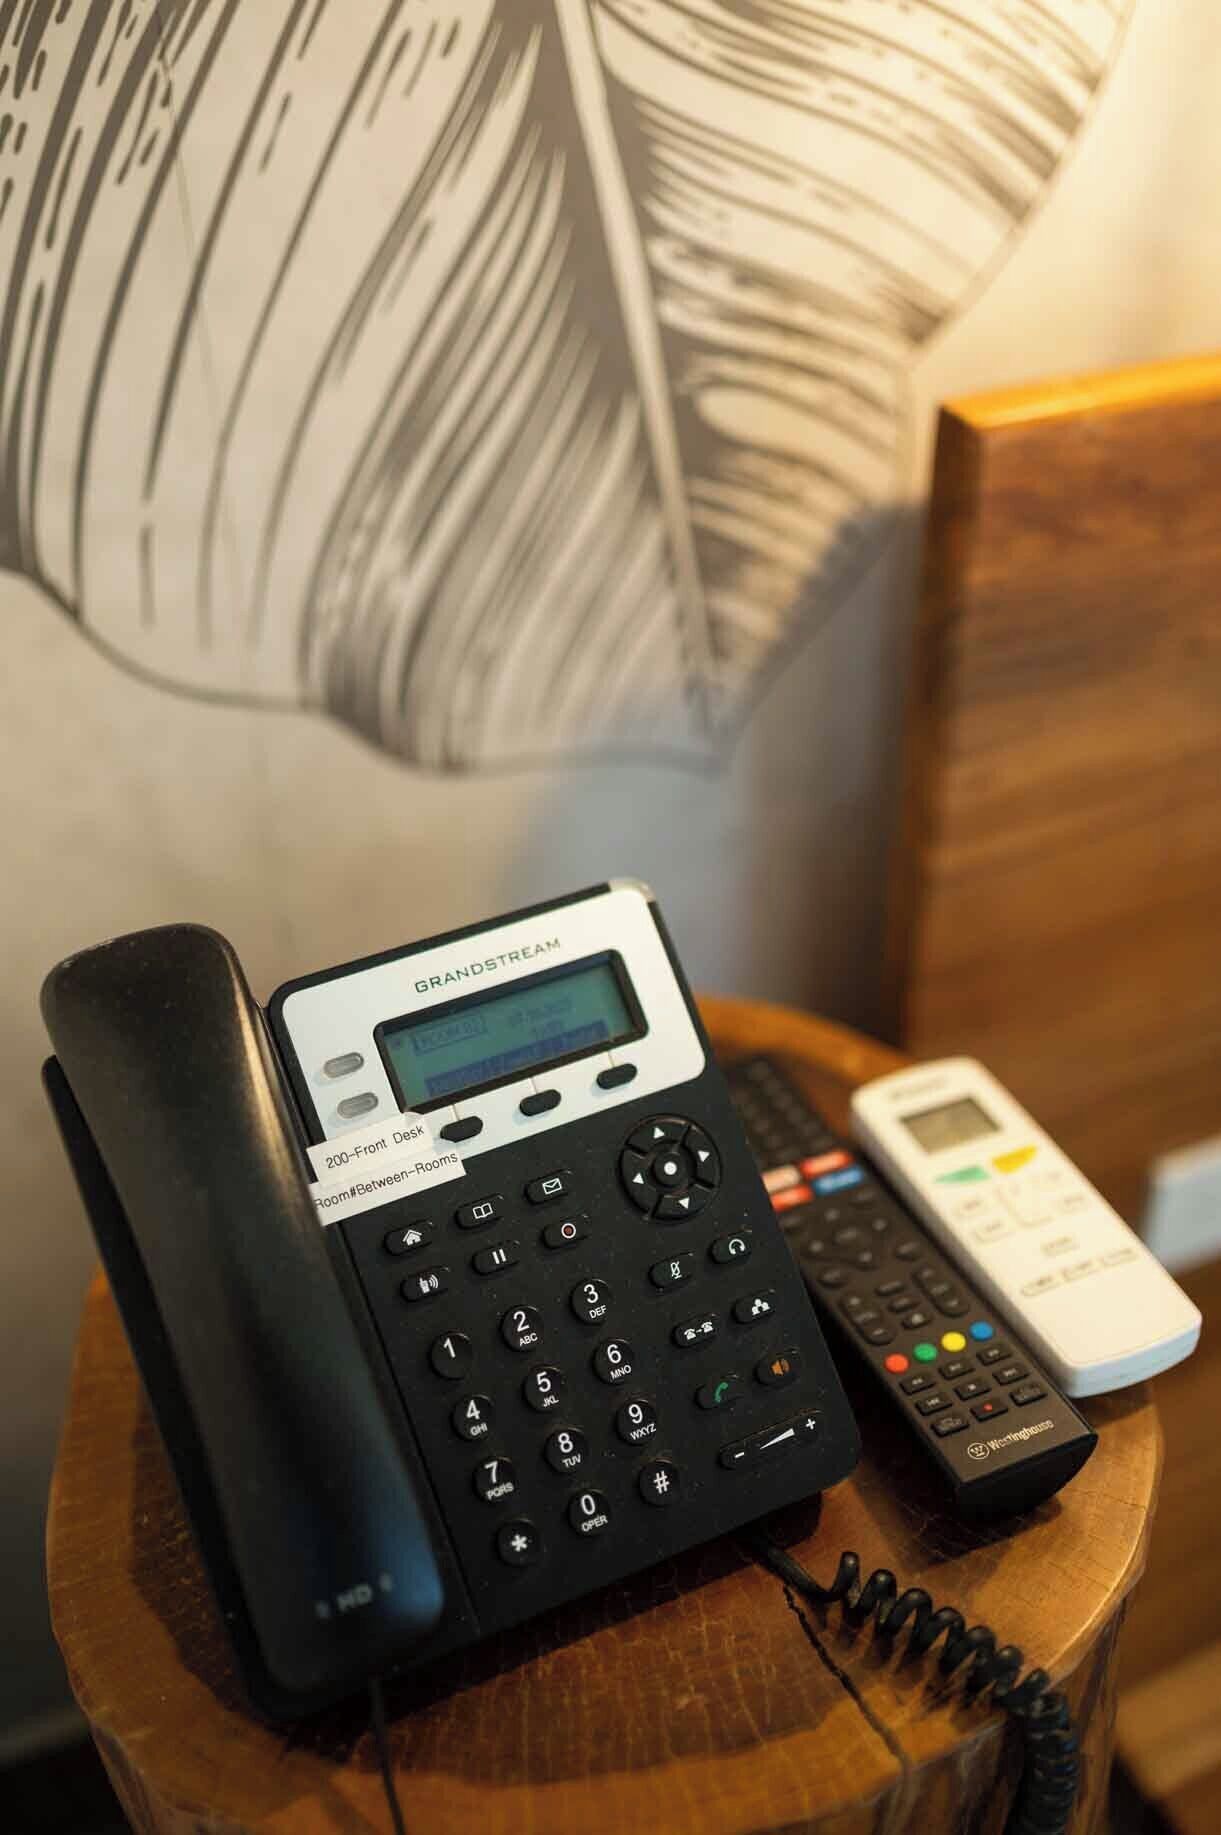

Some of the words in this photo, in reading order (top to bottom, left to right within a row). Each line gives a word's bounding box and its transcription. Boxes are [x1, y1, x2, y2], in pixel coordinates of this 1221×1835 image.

[414, 937, 561, 993] GRANDSTREAM
[326, 1138, 388, 1169] 200-Front
[392, 1124, 425, 1144] Desk
[583, 1284, 599, 1304] 3
[513, 1311, 530, 1332] 2
[589, 1305, 608, 1319] DEF
[443, 1338, 457, 1359] 1
[519, 1332, 538, 1346] ABC
[607, 1344, 622, 1364] 6
[536, 1371, 551, 1393] 5
[610, 1364, 632, 1380] MNO
[466, 1399, 481, 1420] 4
[543, 1395, 560, 1408] JKL
[628, 1404, 644, 1425] 9
[470, 1423, 488, 1436] GHI
[630, 1423, 657, 1441] WXYZ
[987, 1419, 1054, 1449] Westinghouse
[558, 1432, 574, 1454] 8
[562, 1454, 582, 1468] TUV
[484, 1461, 499, 1484] 7
[580, 1494, 596, 1516] 0
[581, 1514, 608, 1532] OPER
